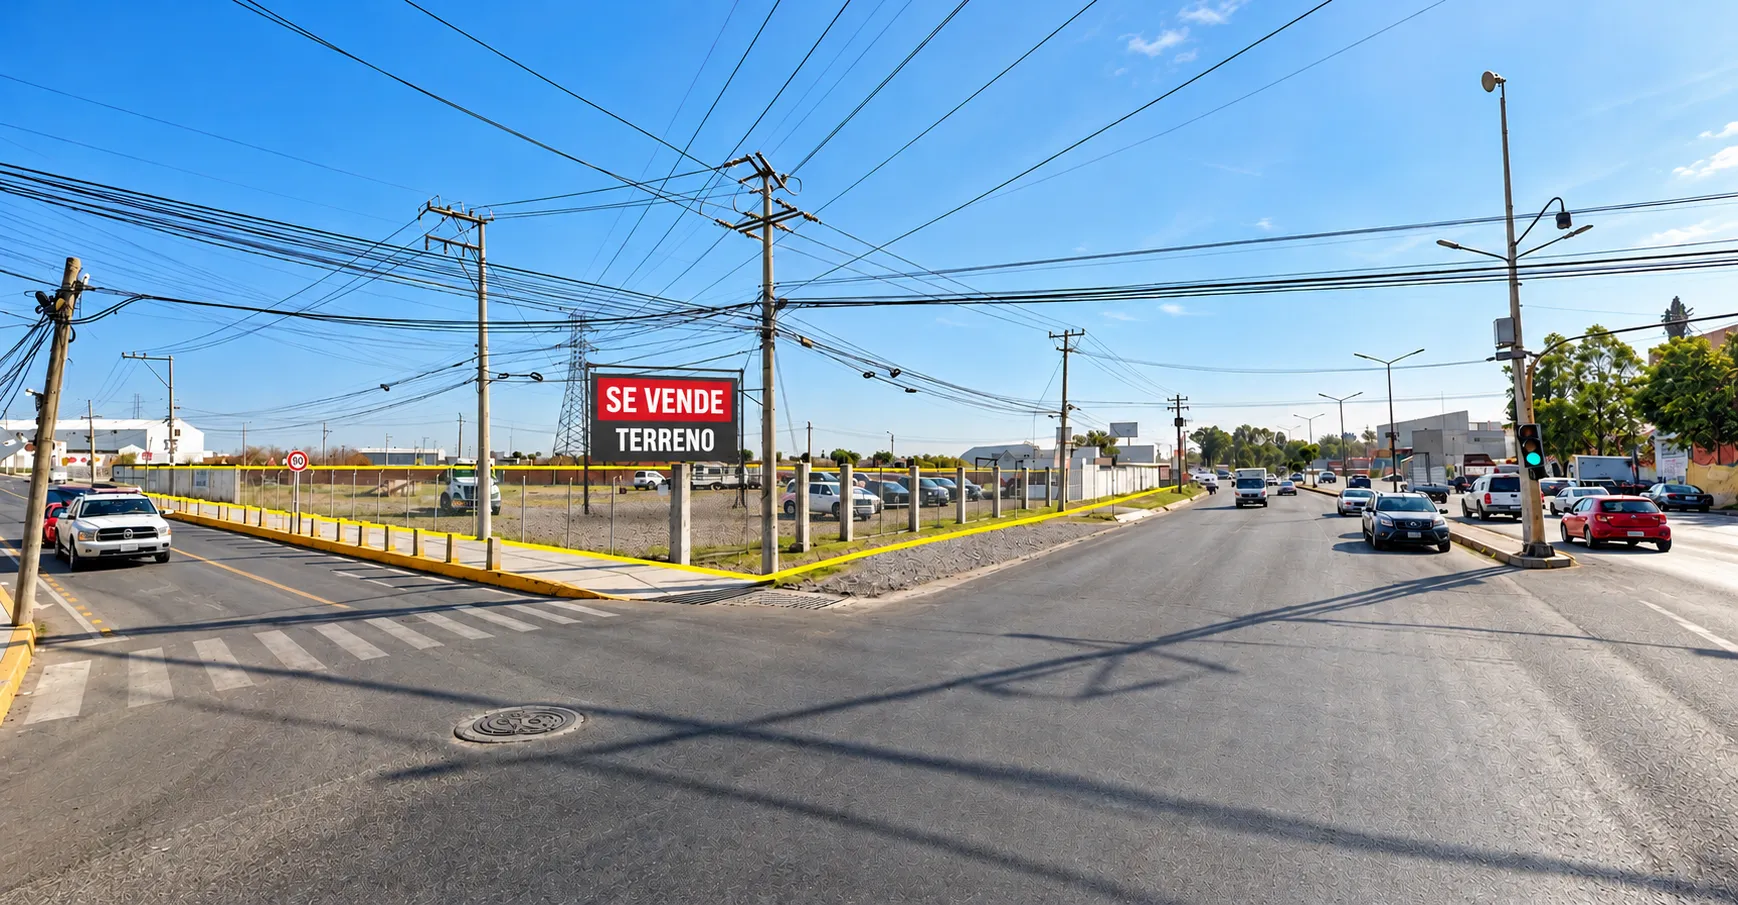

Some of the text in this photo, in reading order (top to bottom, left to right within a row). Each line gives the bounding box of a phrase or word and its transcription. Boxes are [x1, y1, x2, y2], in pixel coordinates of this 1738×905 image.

[606, 386, 724, 414] SE VENDE
[615, 428, 715, 452] TERRENO
